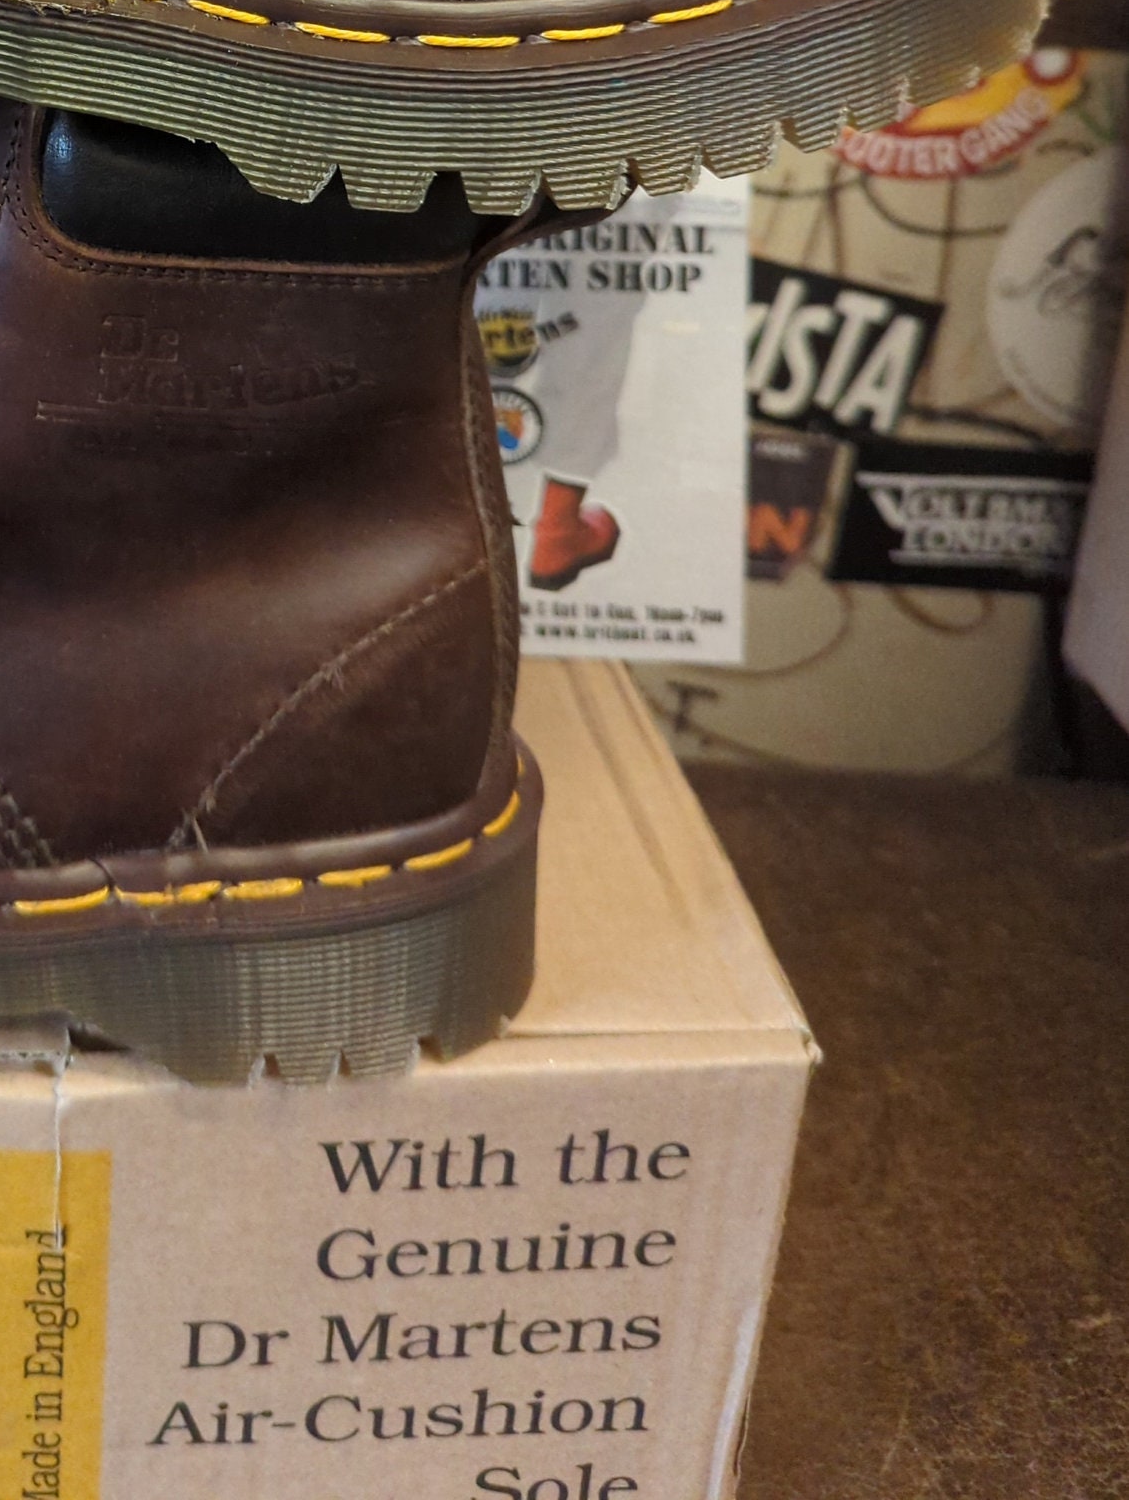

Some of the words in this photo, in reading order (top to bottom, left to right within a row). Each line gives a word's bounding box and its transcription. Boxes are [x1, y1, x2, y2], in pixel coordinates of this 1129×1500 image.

[526, 222, 715, 255] RIGINAL
[588, 260, 702, 293] SHOP
[746, 276, 922, 438] ISTA
[319, 1134, 518, 1195] With
[555, 1128, 692, 1187] the
[316, 1222, 677, 1282] Genuine
[24, 1224, 80, 1379] England
[182, 1318, 290, 1369] Dr
[320, 1307, 663, 1365] Martens
[26, 1389, 62, 1422] in
[148, 1387, 649, 1446] Air-Cushion
[472, 1463, 639, 1500] Sole
